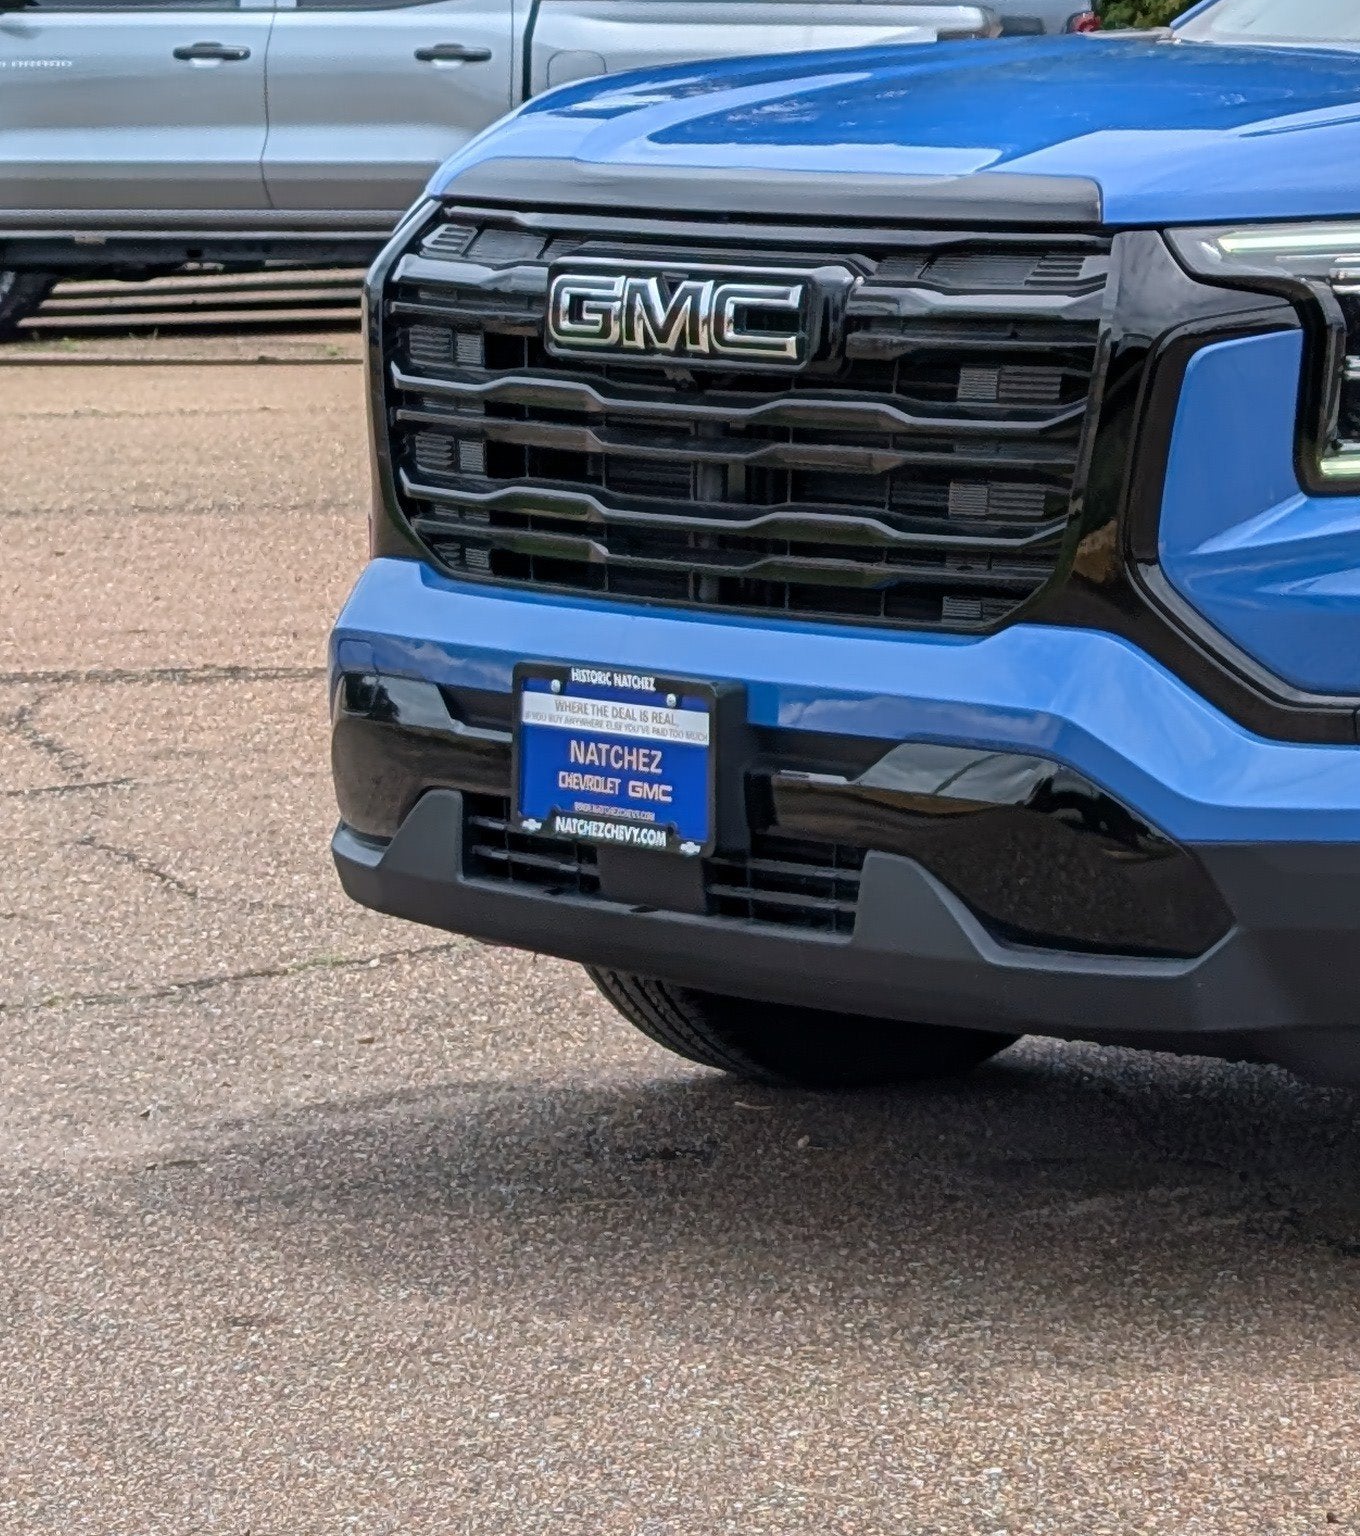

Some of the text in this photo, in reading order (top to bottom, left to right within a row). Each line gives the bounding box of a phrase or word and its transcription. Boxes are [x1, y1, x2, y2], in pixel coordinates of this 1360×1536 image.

[550, 274, 802, 359] GMC
[571, 667, 657, 692] HISTORIC NATCHEZ
[555, 699, 589, 715] WHERE
[590, 703, 608, 718] THE
[611, 706, 637, 722] DEAL
[640, 710, 649, 723] IS
[652, 726, 668, 737] PAID
[570, 739, 663, 774] NATCHEZ
[558, 770, 673, 803] CHEVROLET GMC
[555, 816, 667, 847] NATCHEZCHEVY.COM
